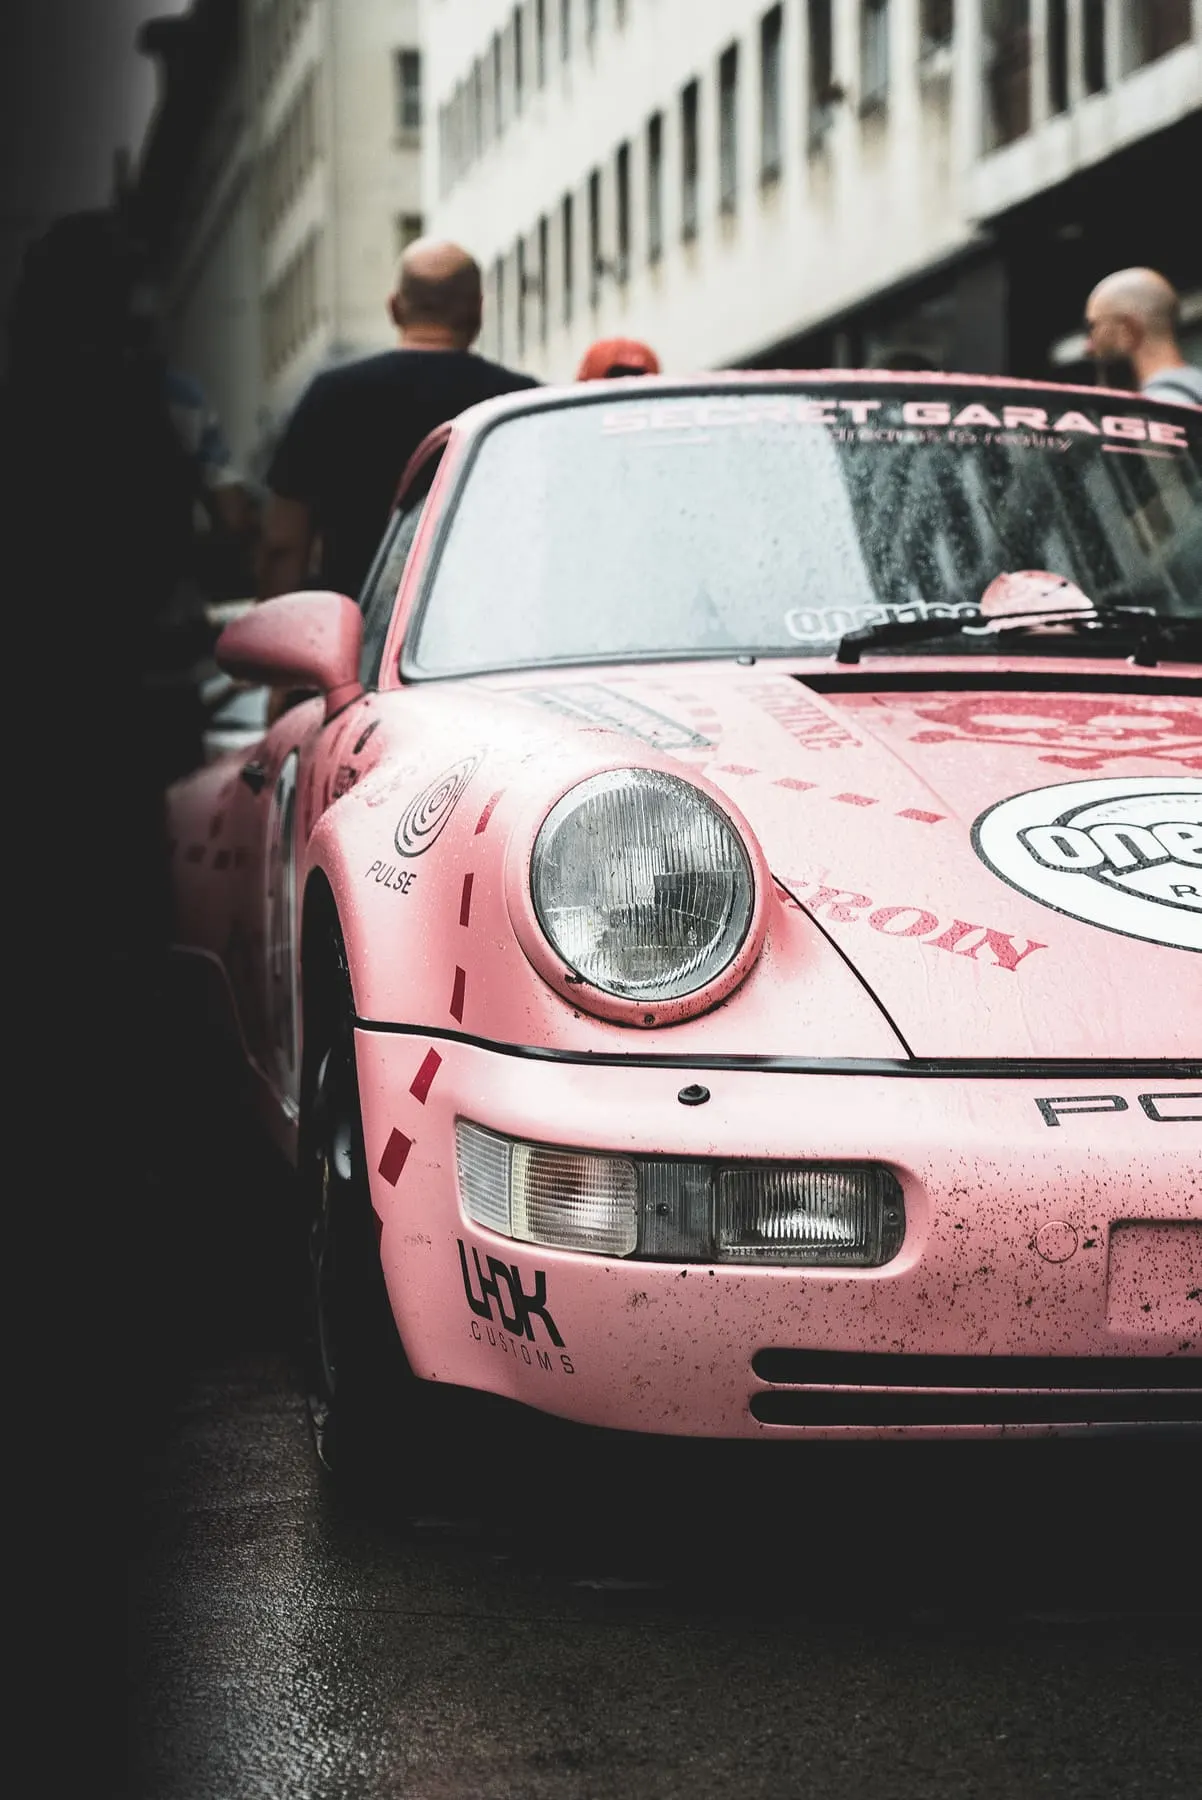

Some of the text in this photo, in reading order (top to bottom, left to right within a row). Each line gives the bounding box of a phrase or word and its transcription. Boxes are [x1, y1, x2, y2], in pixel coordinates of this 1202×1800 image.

[600, 401, 1189, 448] SECRET GARAGE
[364, 860, 418, 895] PULSE
[470, 1320, 575, 1374] CUSTOMS
